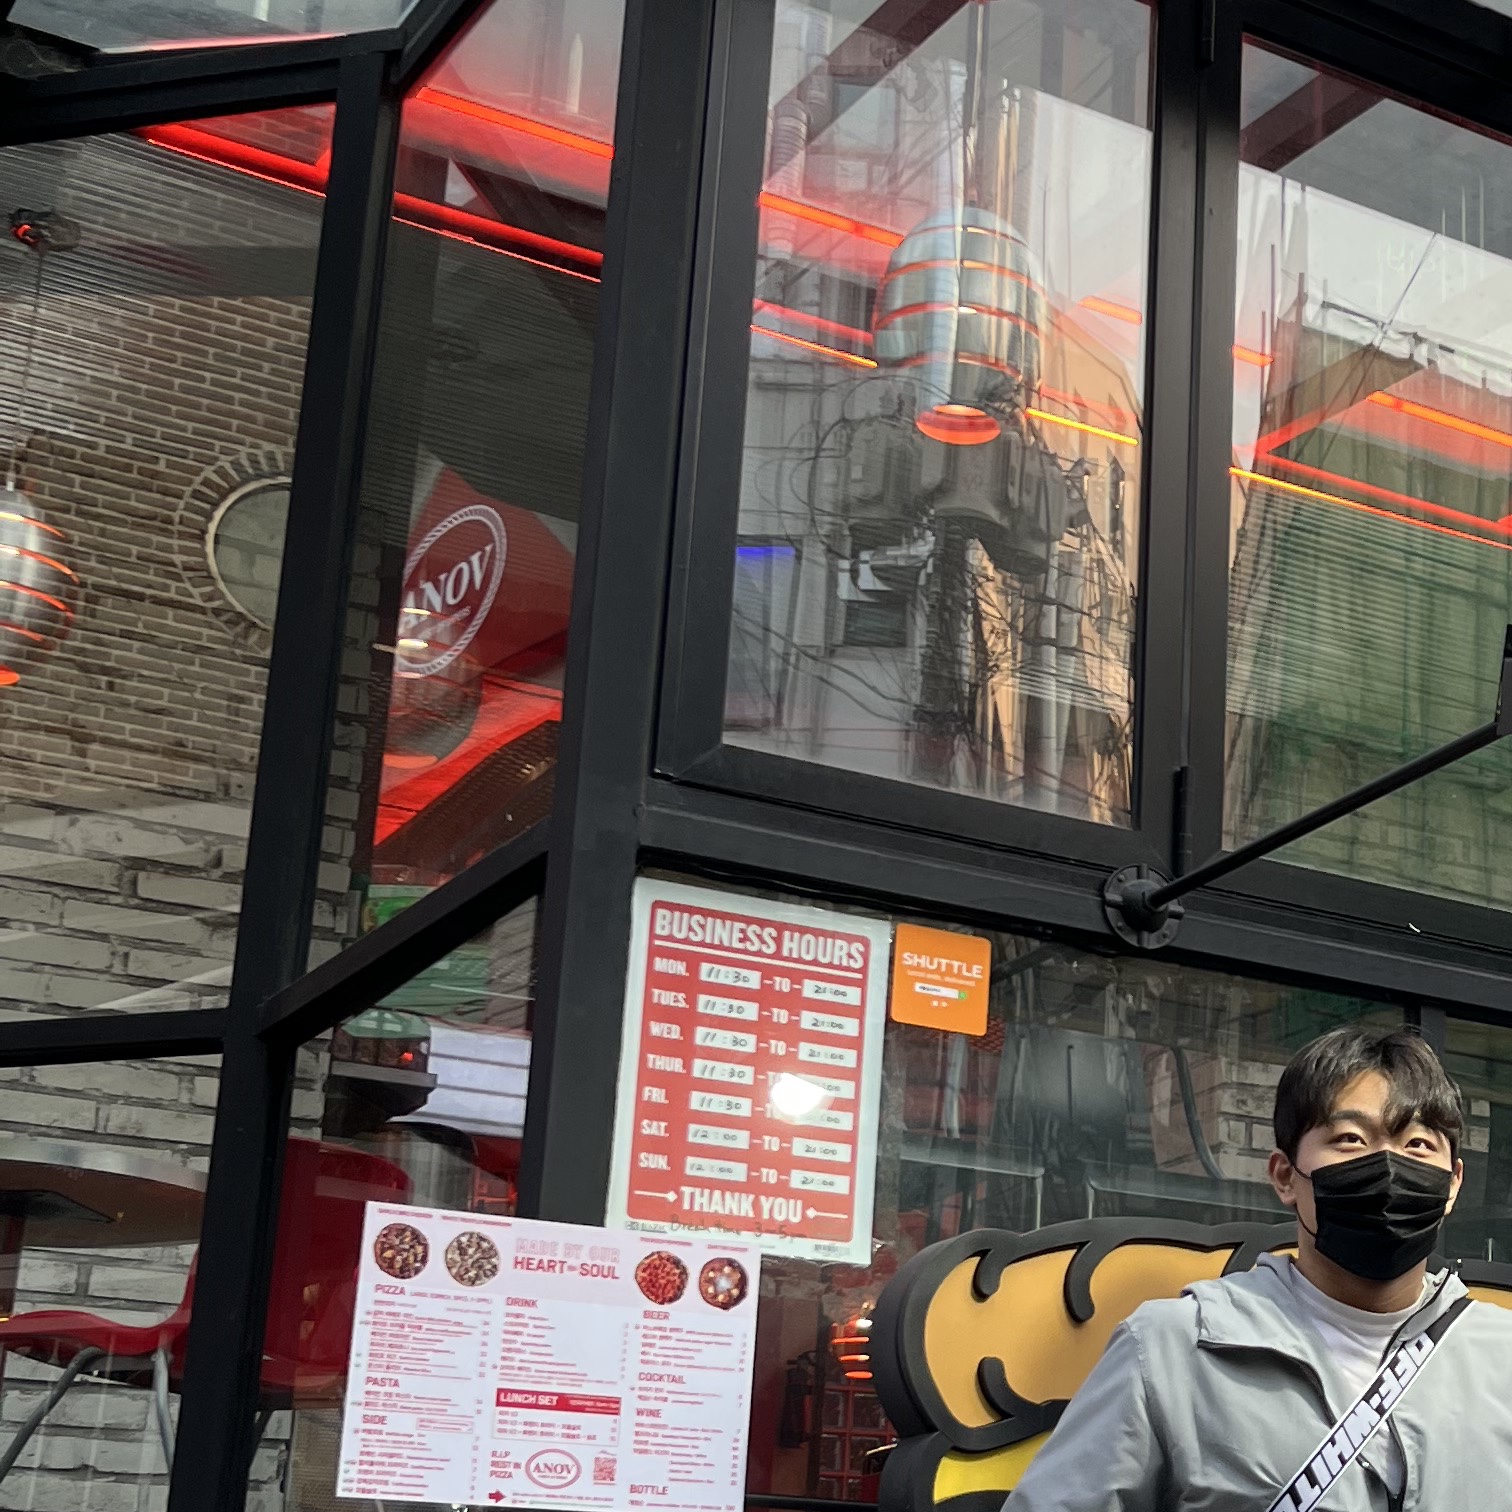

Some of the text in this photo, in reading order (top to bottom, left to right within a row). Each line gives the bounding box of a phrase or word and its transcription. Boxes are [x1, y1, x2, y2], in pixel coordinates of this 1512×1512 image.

[401, 545, 494, 629] ANOV
[654, 908, 866, 969] BUSINESS HOURS
[654, 957, 690, 977] MON.
[902, 951, 984, 979] SHUTTLE
[652, 988, 689, 1008] TUES.
[650, 1020, 684, 1041] WED.
[647, 1053, 687, 1074] THUR.
[643, 1086, 669, 1104] FRI.
[640, 1119, 669, 1137] SAT.
[638, 1152, 671, 1171] SUN.
[680, 1185, 803, 1223] THANK YOU
[516, 1237, 620, 1263] MADE BY OUR
[513, 1256, 567, 1275] HEART
[579, 1262, 620, 1280] SOUL
[374, 1283, 405, 1296] PIZZA
[505, 1296, 538, 1309] DRINK
[365, 1376, 400, 1388] PASTA
[638, 1372, 686, 1385] COCKTAIL
[500, 1392, 536, 1405] LUNCH
[538, 1394, 559, 1406] SET
[362, 1414, 388, 1425] SIDE
[533, 1462, 576, 1475] ANOV
[629, 1484, 669, 1496] BOTTLE
